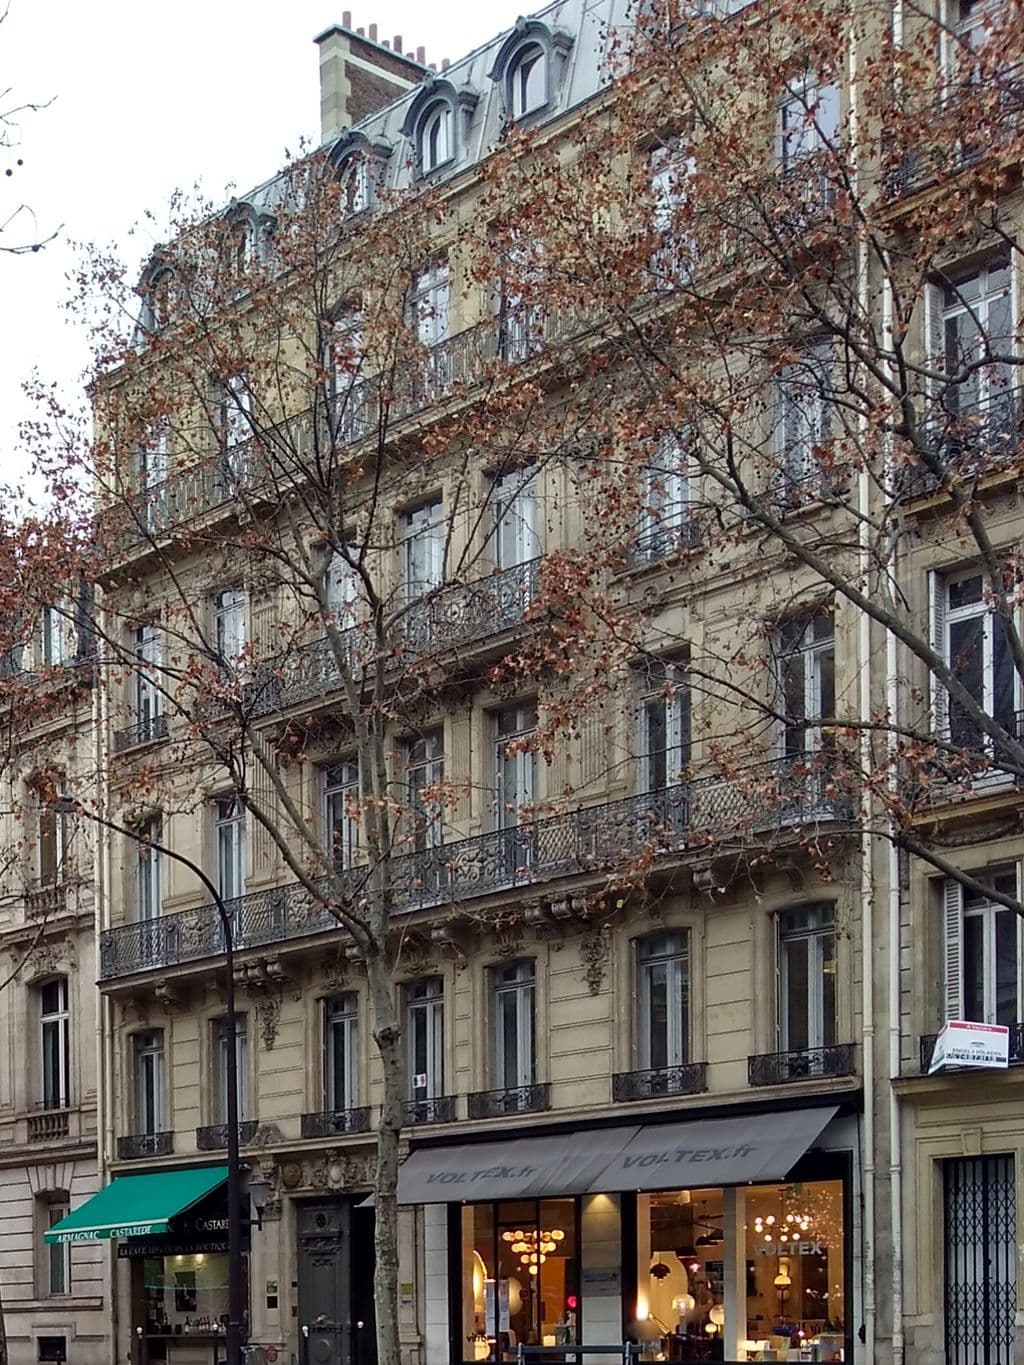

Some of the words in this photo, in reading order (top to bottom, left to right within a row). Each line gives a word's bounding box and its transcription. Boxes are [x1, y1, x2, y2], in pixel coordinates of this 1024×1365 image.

[622, 1144, 757, 1169] VOLTEX.fr
[426, 1165, 538, 1184] VOLTEX.fr
[195, 1217, 230, 1232] CASTARE
[56, 1231, 101, 1243] ARMAGNAC
[194, 1242, 231, 1252] BOUTIQU
[756, 1241, 822, 1256] VOLTEX
